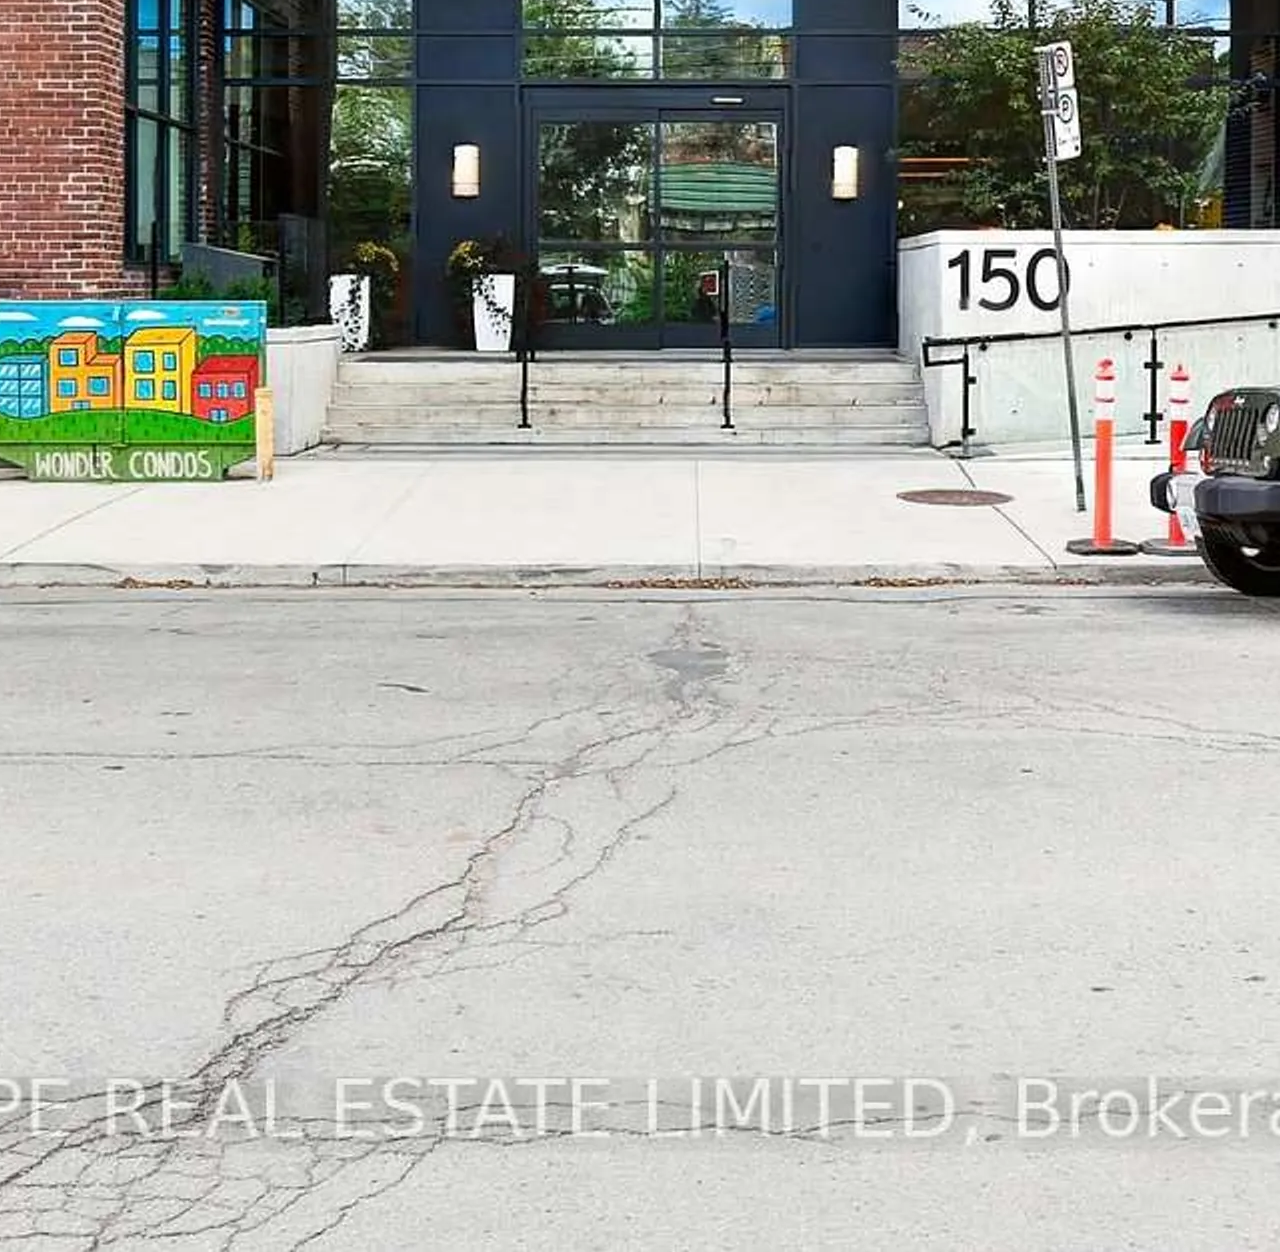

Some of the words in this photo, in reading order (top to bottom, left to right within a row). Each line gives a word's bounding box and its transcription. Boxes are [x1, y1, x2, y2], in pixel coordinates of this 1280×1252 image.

[948, 248, 1070, 311] 150
[35, 451, 119, 479] WONDER
[129, 450, 213, 479] CONDOS
